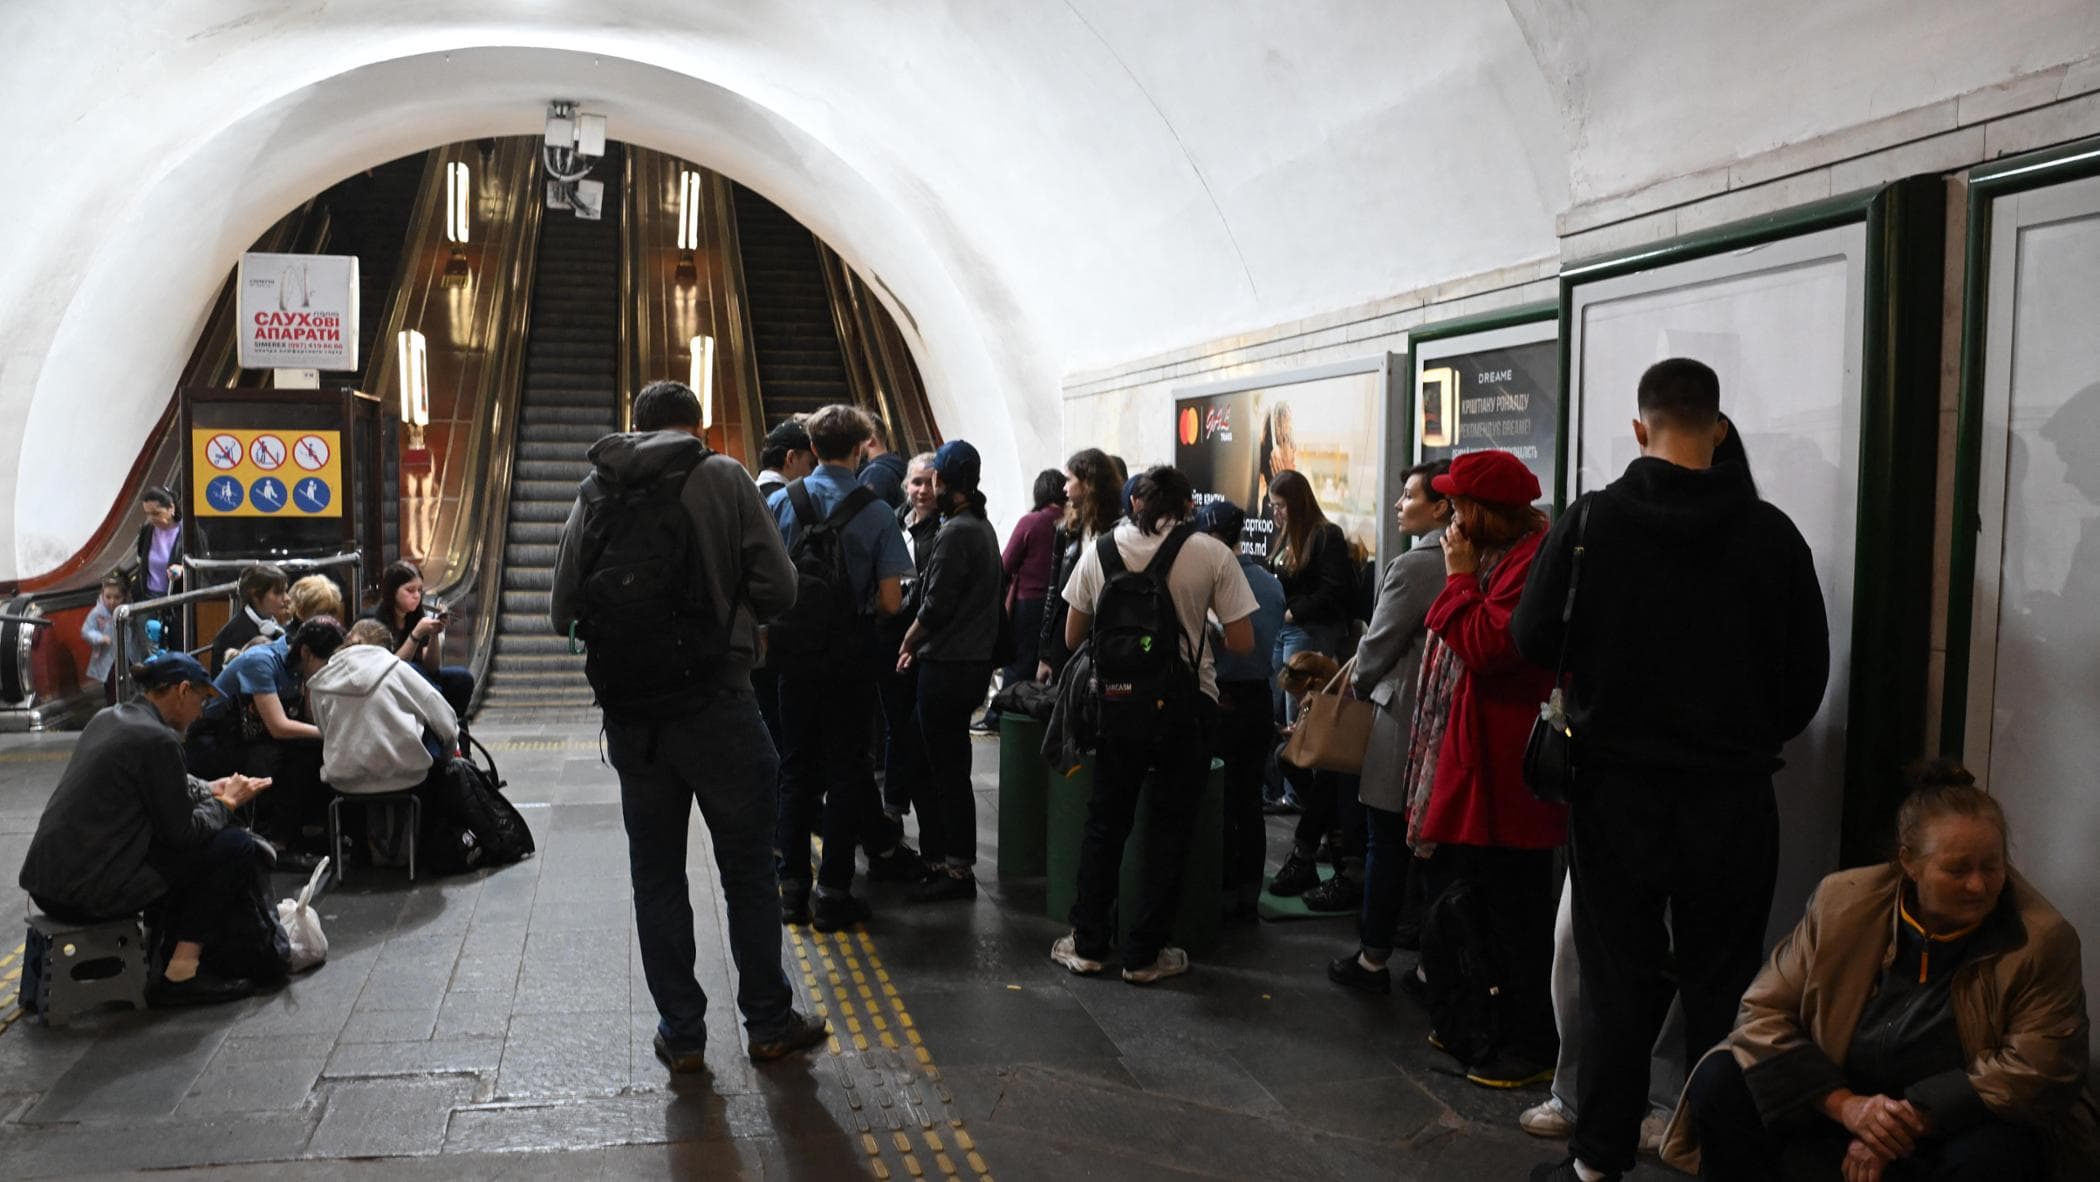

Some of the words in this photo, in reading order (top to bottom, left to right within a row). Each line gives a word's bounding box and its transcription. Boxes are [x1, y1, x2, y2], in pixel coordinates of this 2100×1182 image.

[254, 312, 340, 326] СЛУХОВІ
[254, 328, 340, 340] АПАРАТИ
[1478, 369, 1512, 384] DREAME
[1240, 535, 1267, 556] ans.md
